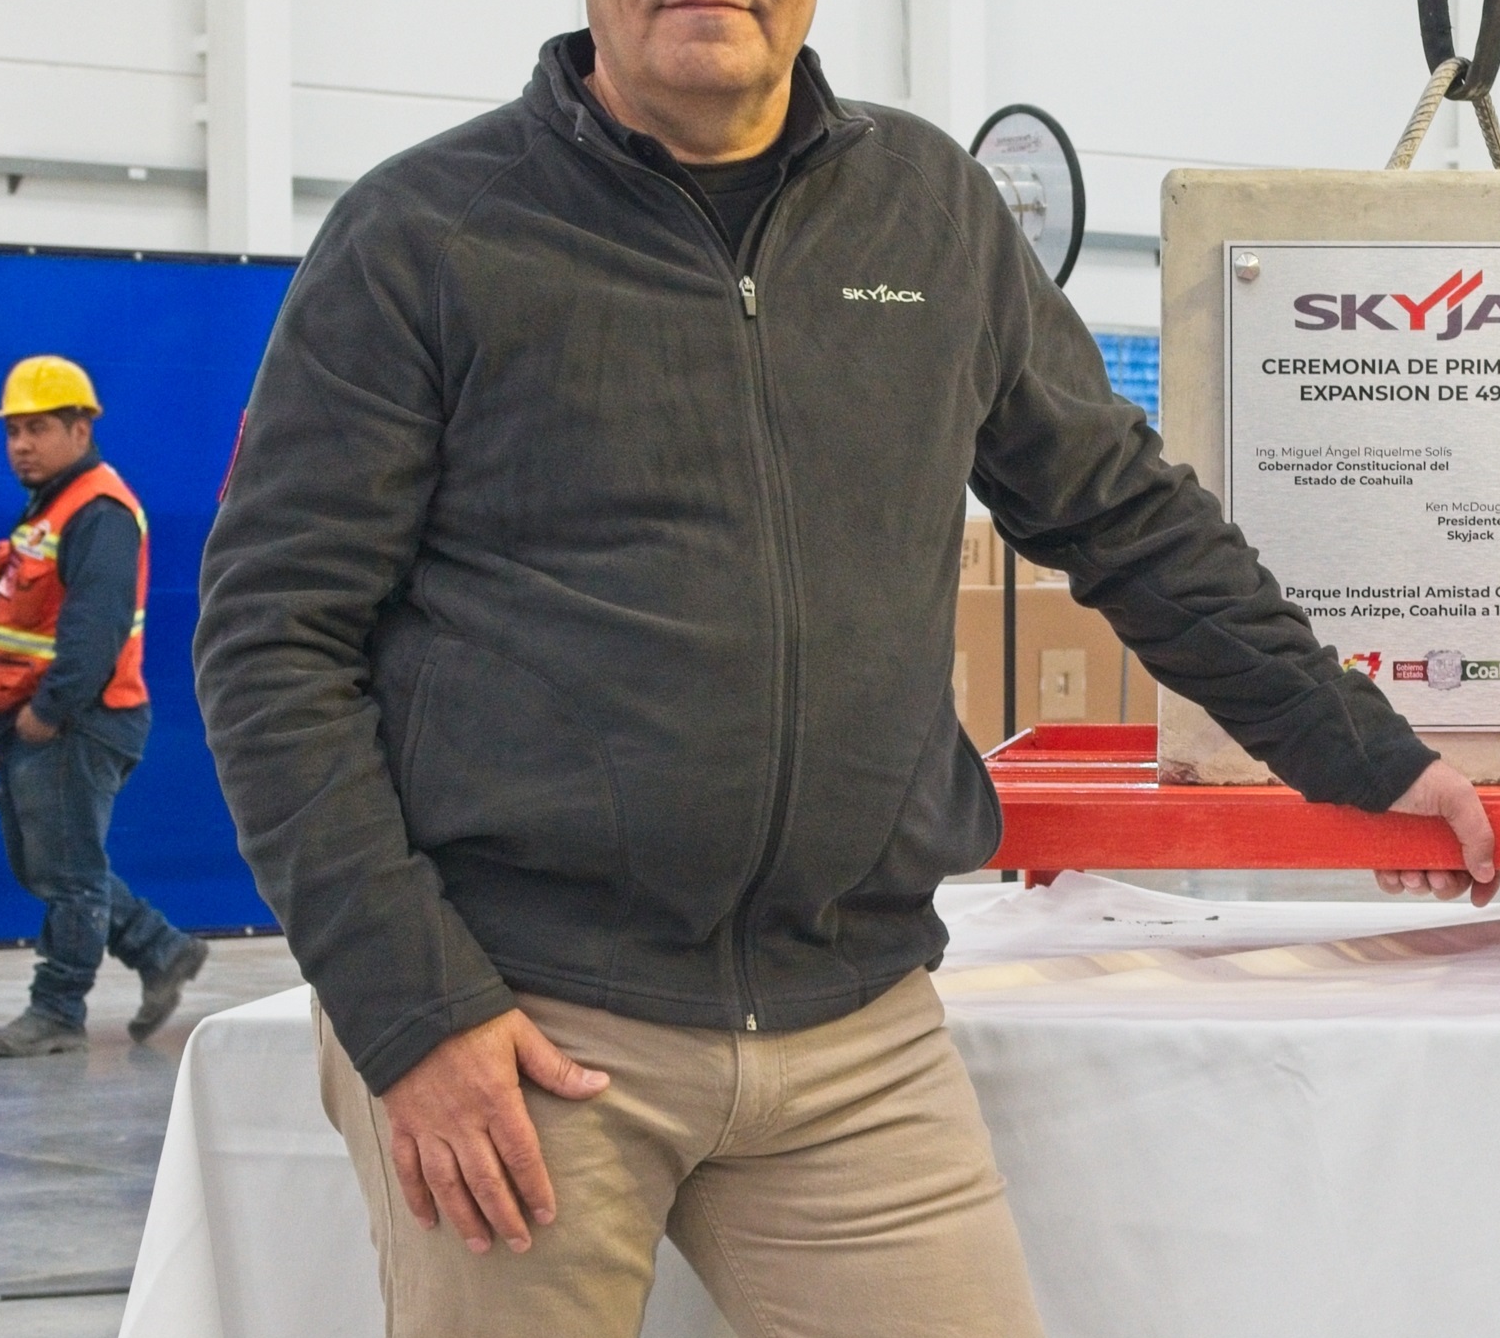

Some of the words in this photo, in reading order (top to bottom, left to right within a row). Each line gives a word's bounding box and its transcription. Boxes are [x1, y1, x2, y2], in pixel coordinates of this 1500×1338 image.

[842, 283, 926, 303] SKYJACK
[1262, 359, 1400, 374] CEREMONIA
[1408, 359, 1438, 374] DE
[1301, 385, 1429, 401] EXPANSION
[1439, 386, 1468, 401] DE
[1256, 447, 1279, 460] Ing.
[1281, 446, 1322, 459] Miguel
[1325, 445, 1361, 460] Ángel
[1364, 446, 1422, 459] Riquelme
[1425, 446, 1452, 457] Solís
[1258, 461, 1333, 472] Gobernador
[1336, 460, 1427, 471] Constitucional
[1429, 460, 1449, 471] del
[1294, 475, 1337, 486] Estado
[1339, 475, 1356, 486] de
[1359, 474, 1413, 486] Coahuila
[1425, 502, 1449, 512] Ken
[1447, 529, 1495, 543] Skyjack
[1285, 586, 1342, 602] Parque
[1346, 585, 1421, 599] Industrial
[1424, 585, 1490, 598] Amistad
[1350, 603, 1405, 620] Arizpe,
[1409, 603, 1477, 617] Coahuila
[1481, 607, 1490, 617] a
